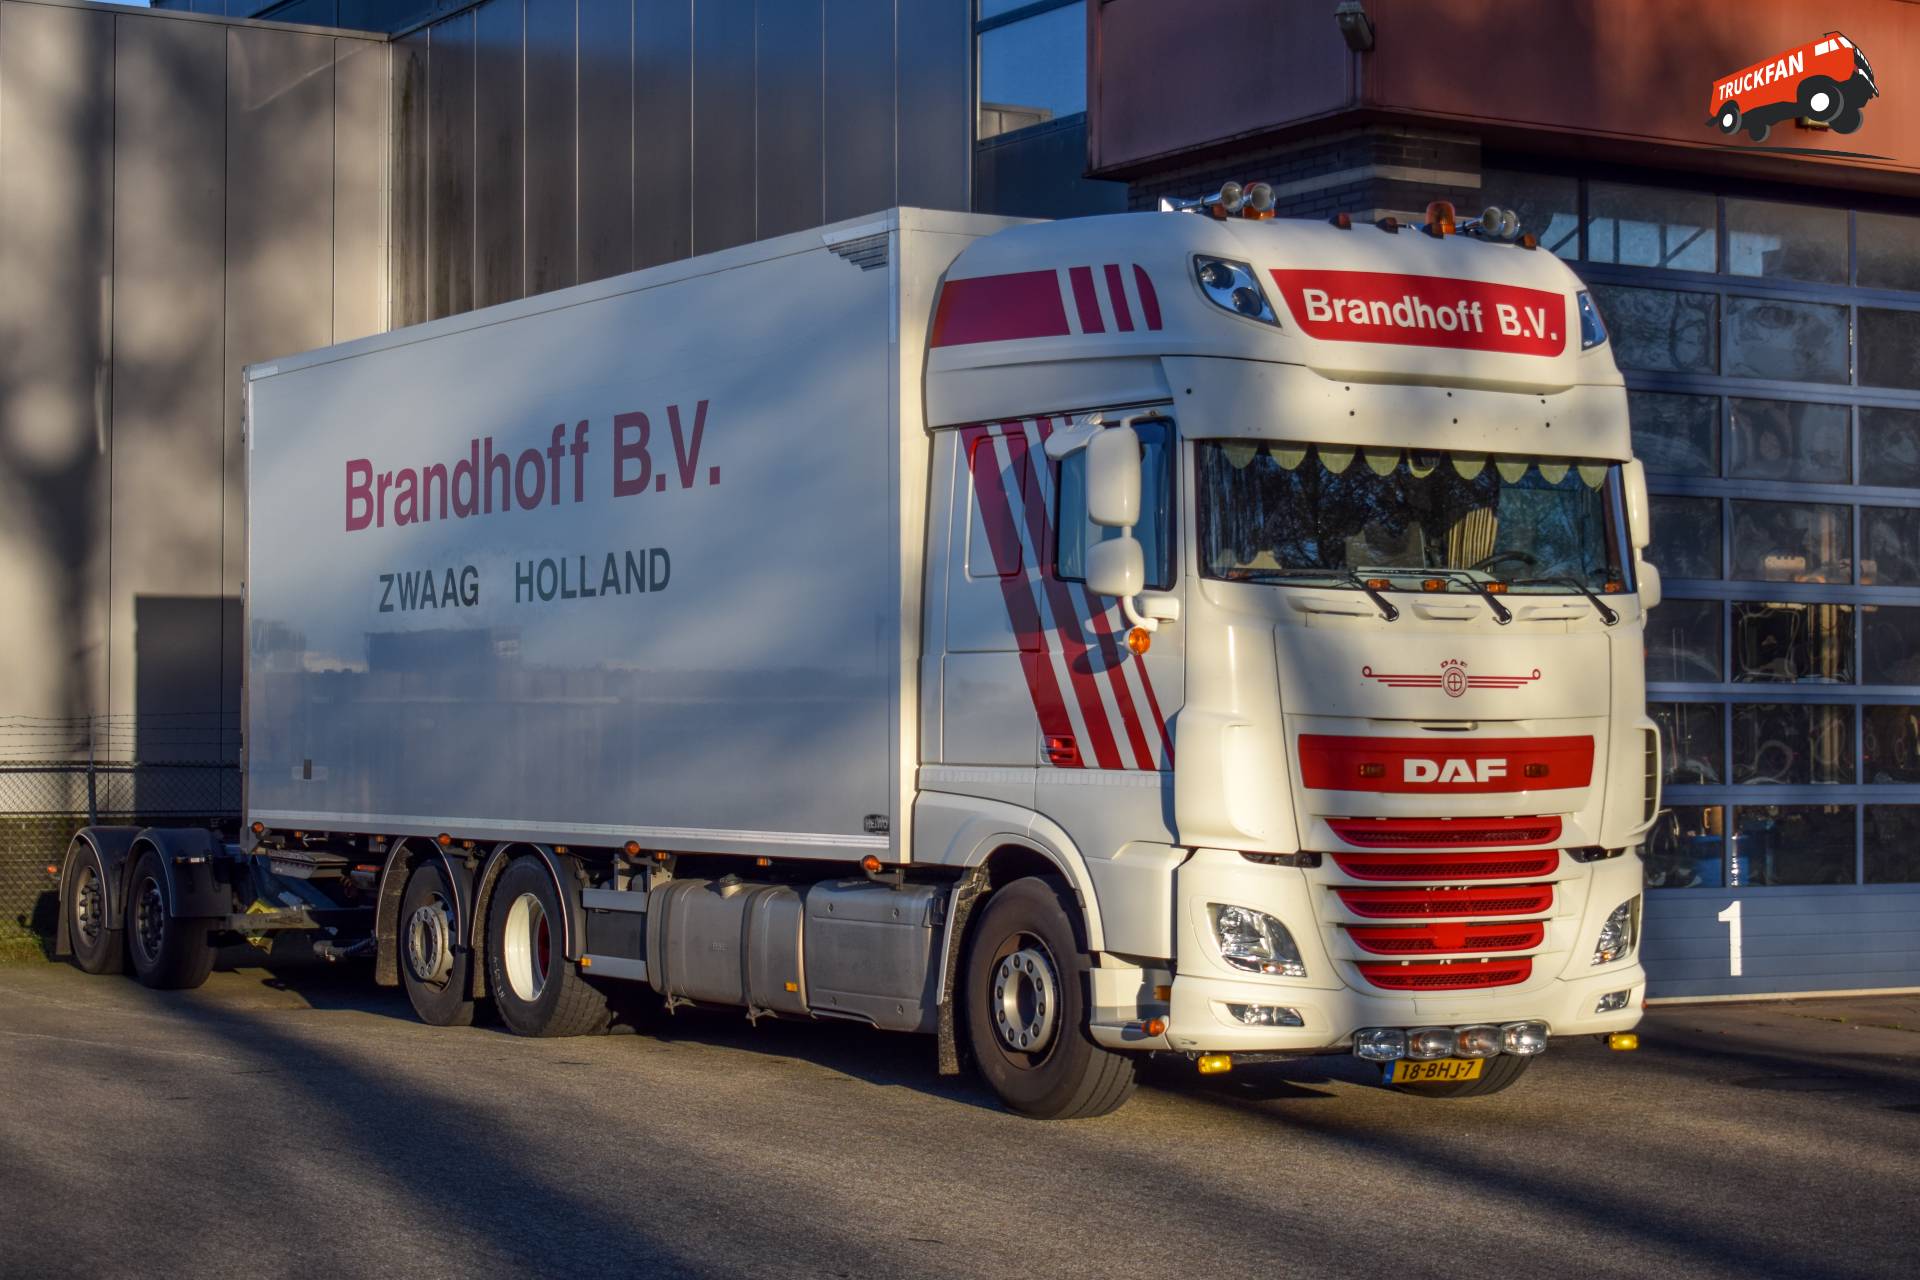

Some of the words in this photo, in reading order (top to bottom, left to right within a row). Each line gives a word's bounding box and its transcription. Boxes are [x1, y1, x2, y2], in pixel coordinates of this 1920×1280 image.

[1303, 288, 1483, 333] Brandhoff
[1496, 303, 1558, 341] B.V.
[345, 419, 589, 532] Brandhoff
[613, 399, 721, 498] B.V.
[379, 565, 479, 613] ZWAAG
[515, 547, 671, 604] HOLLAND
[1403, 758, 1507, 783] DAF
[1718, 900, 1742, 976] 1
[1402, 1061, 1475, 1080] 18-BHJ-7
